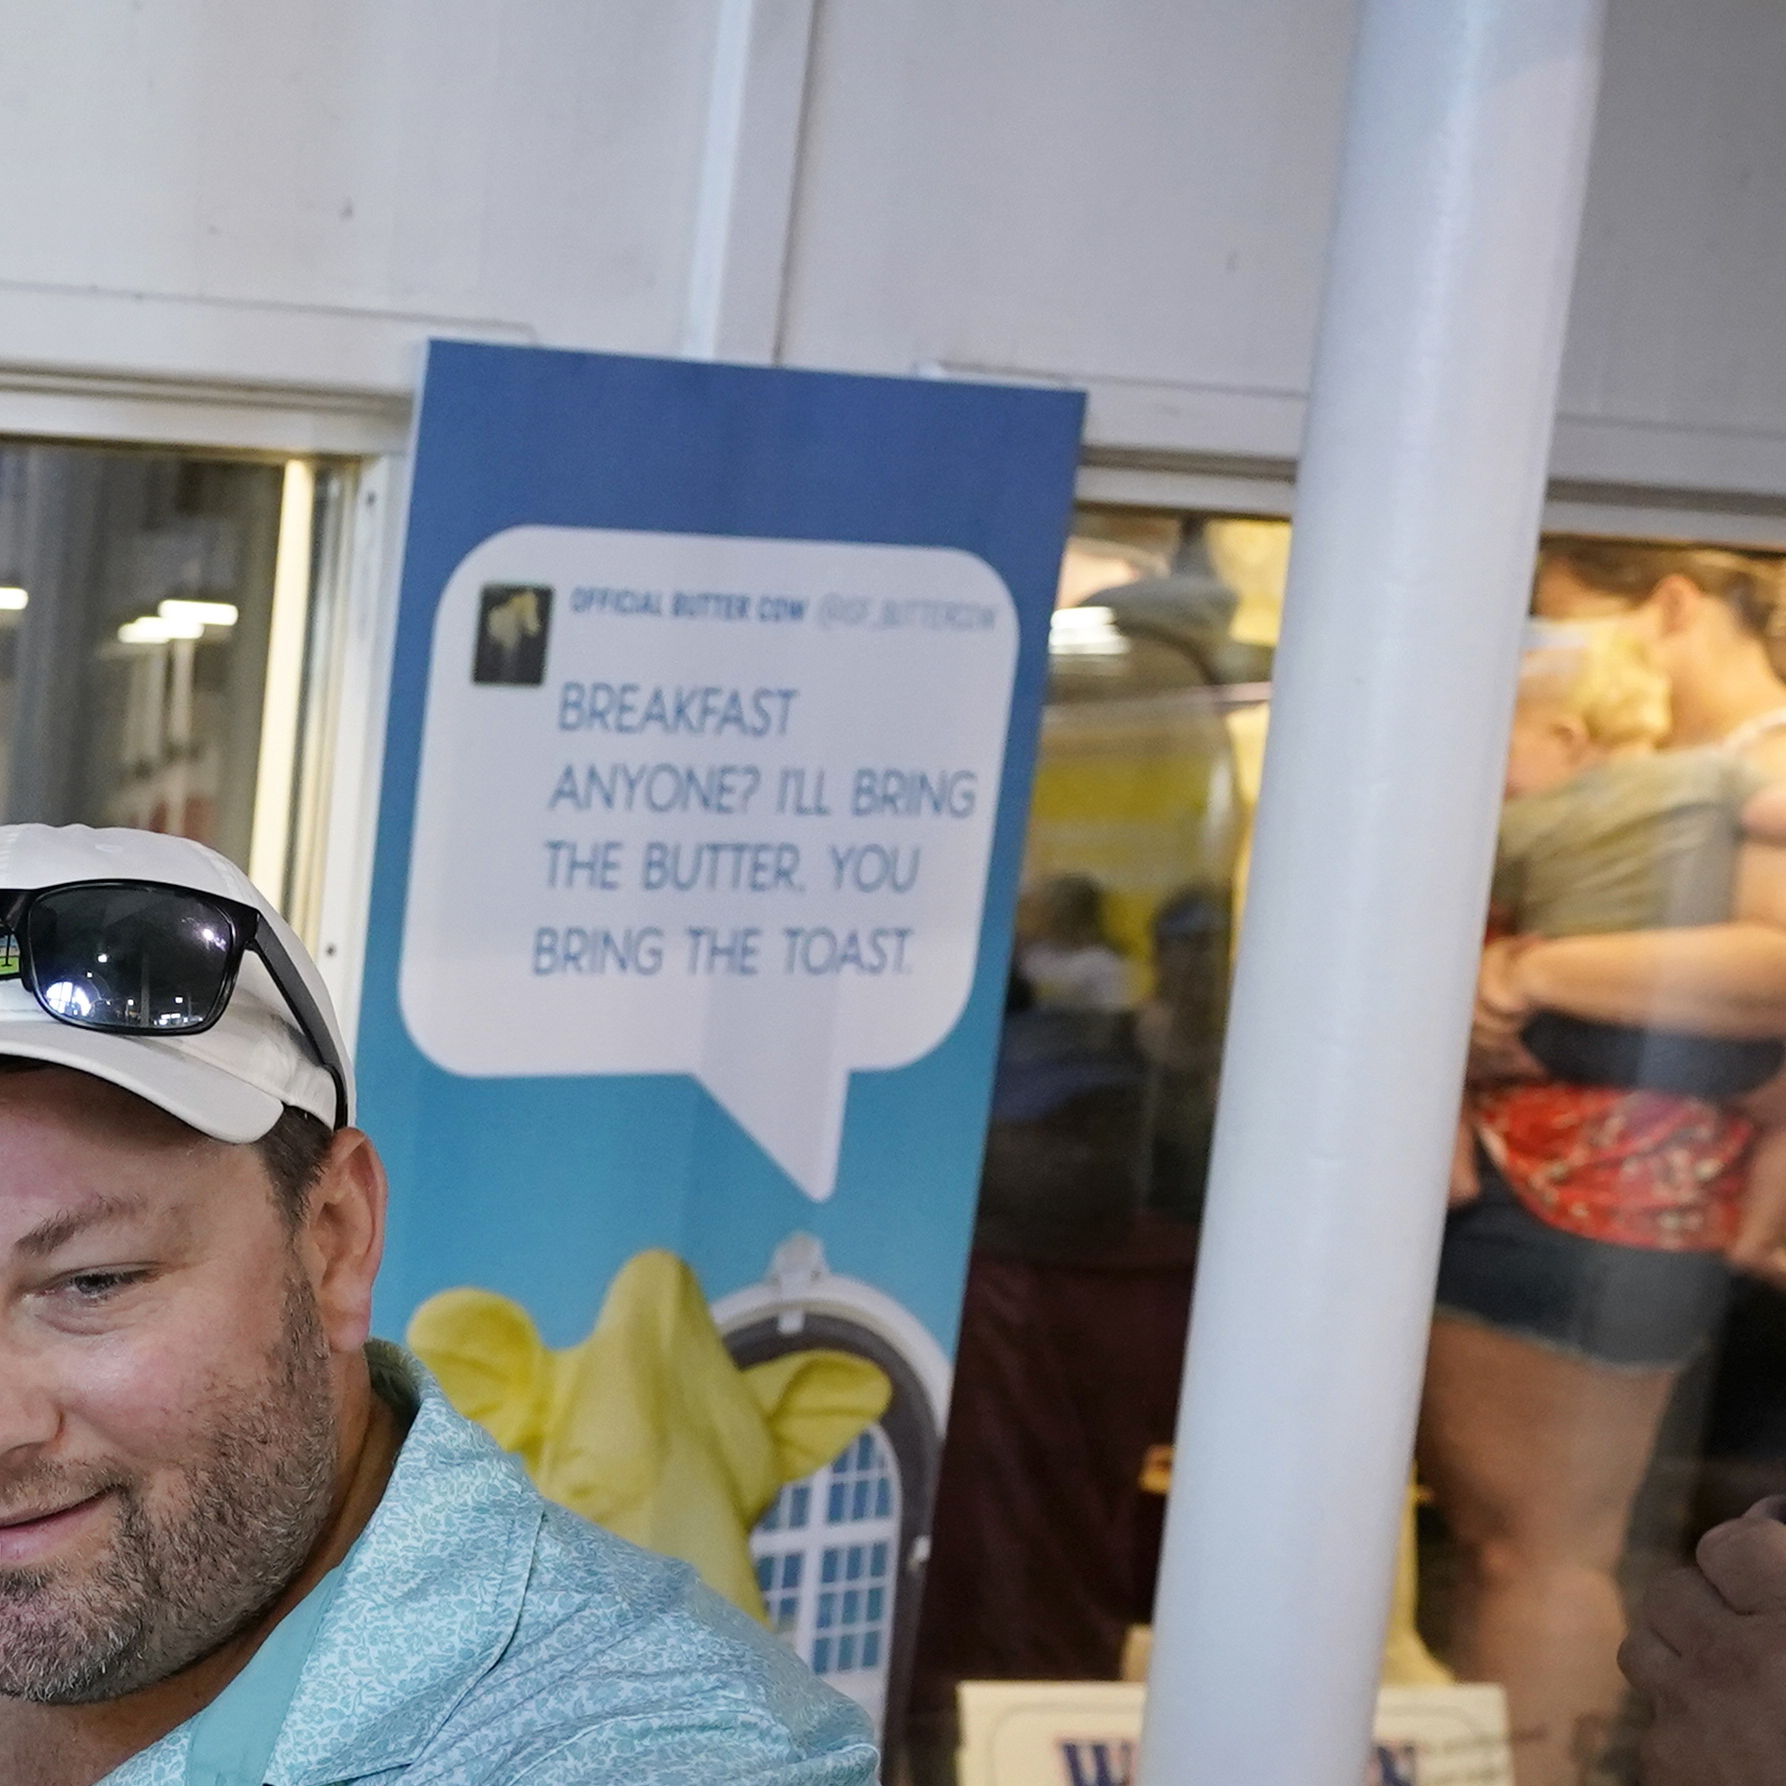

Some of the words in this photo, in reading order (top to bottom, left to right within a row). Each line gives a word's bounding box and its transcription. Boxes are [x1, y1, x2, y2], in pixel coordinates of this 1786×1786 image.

[570, 586, 663, 617] OFFICIAL
[673, 590, 750, 621] BUTTER
[757, 593, 808, 623] COW
[558, 681, 798, 737] BREAKFAST
[547, 763, 761, 816] ANYONE?
[775, 769, 831, 817] I'LL
[850, 769, 978, 819] BRING
[543, 840, 623, 891] THE
[640, 842, 806, 894] BUTTER.
[828, 843, 921, 894] YOU
[533, 927, 664, 976] BRING
[685, 928, 761, 975] THE
[779, 927, 915, 976] TOAST.
